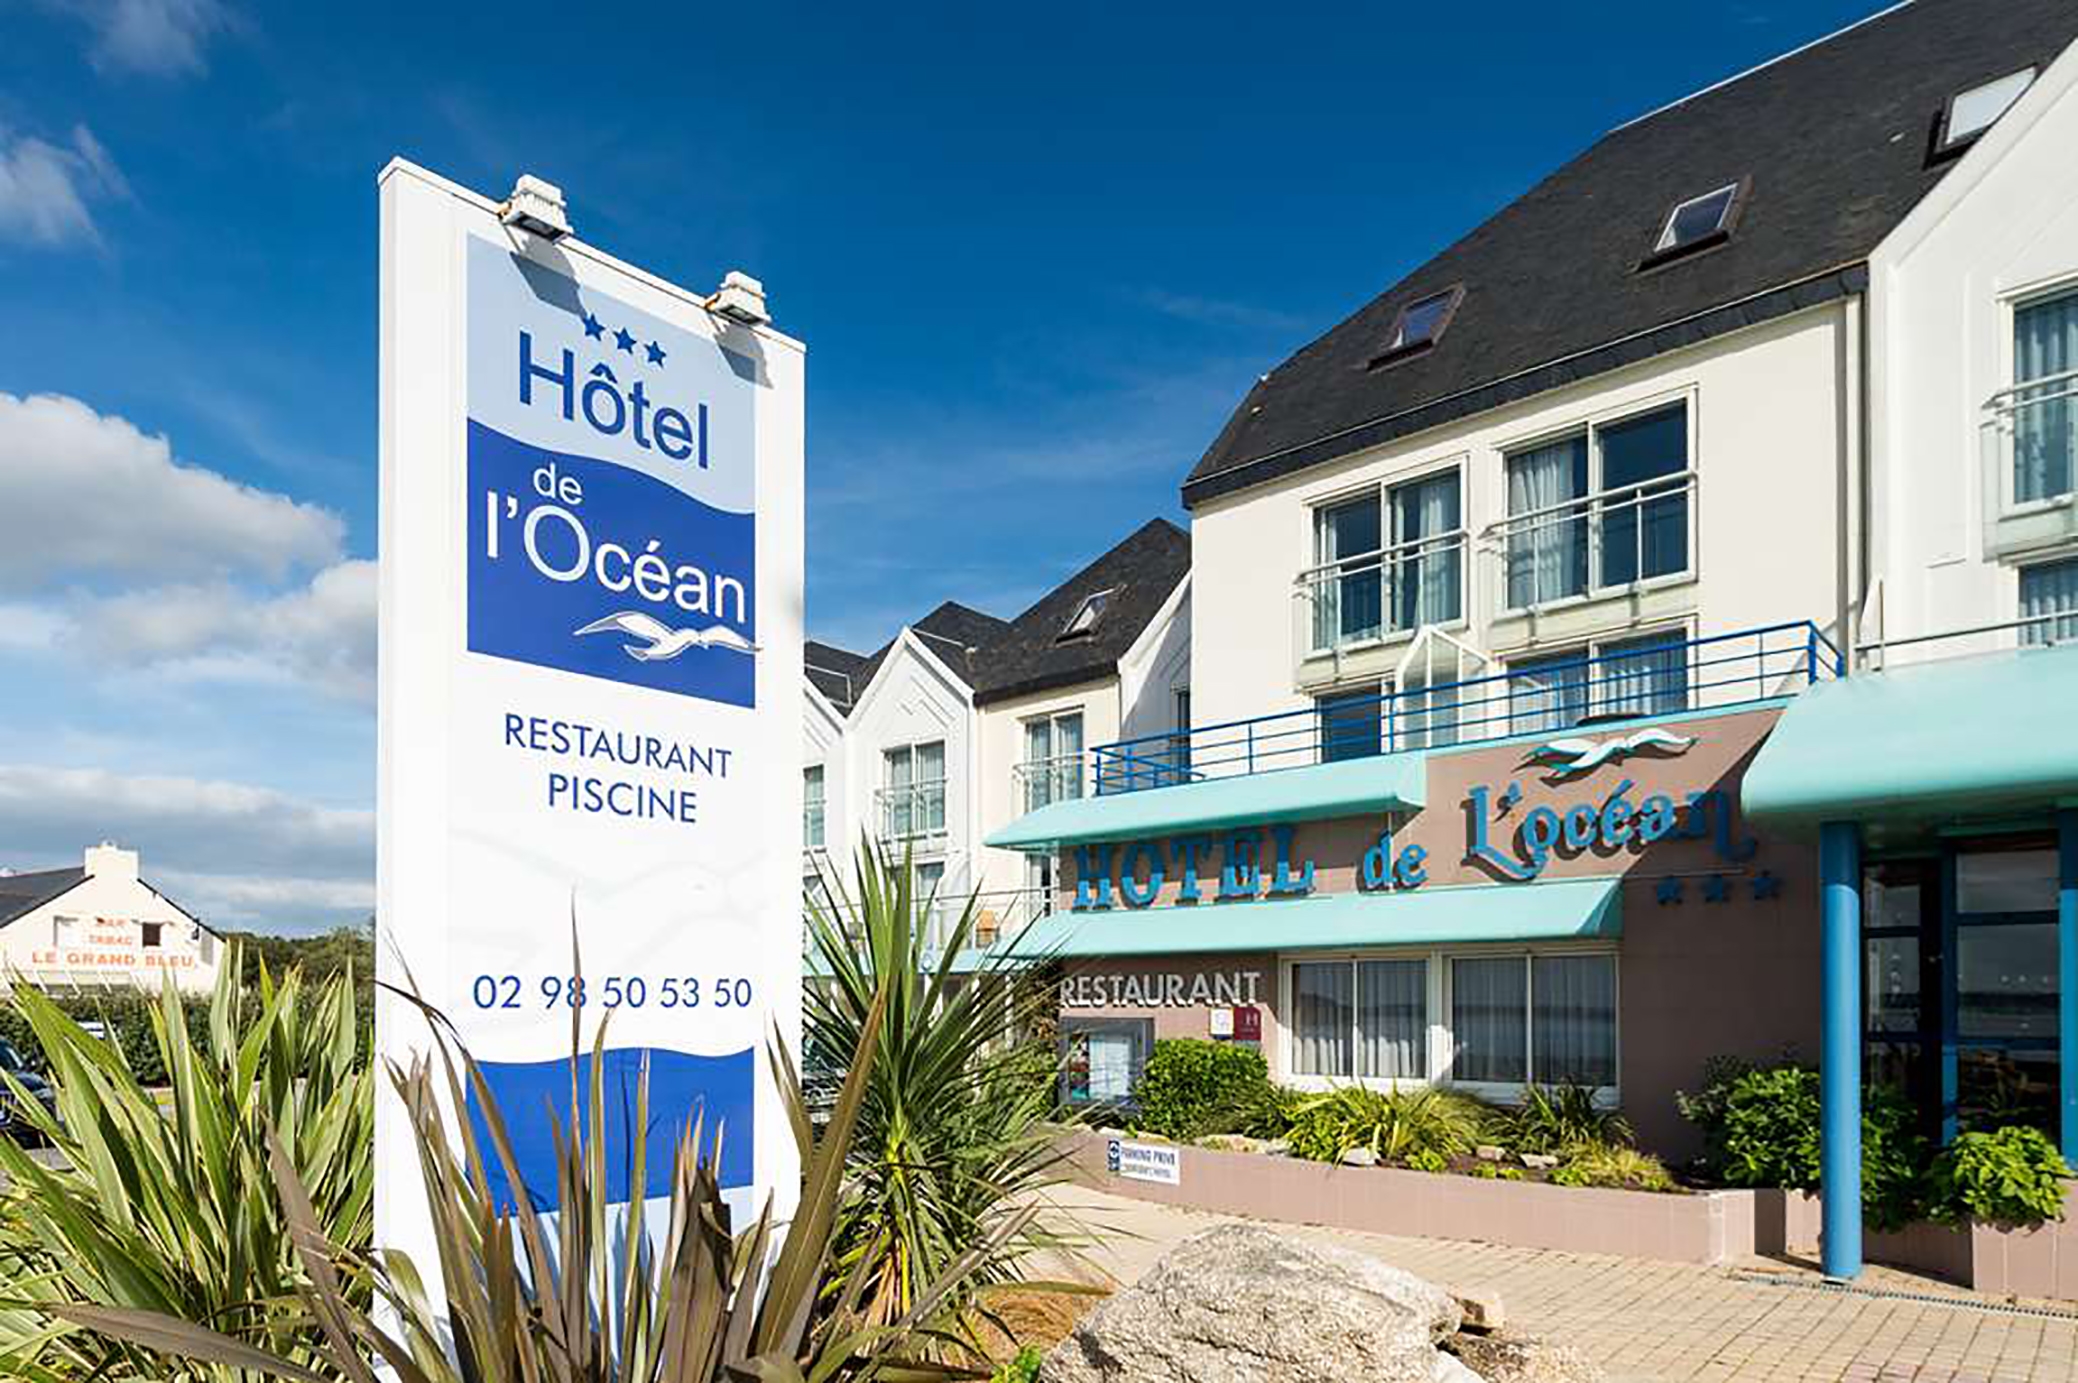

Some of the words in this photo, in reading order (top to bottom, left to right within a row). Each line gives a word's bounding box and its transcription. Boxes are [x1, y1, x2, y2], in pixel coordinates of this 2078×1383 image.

[519, 329, 708, 470] Hôtel
[533, 462, 584, 505] de
[505, 712, 733, 779] RESTAURANT
[549, 772, 698, 824] PISCINE
[1072, 824, 1316, 910] HOTEL
[1360, 829, 1429, 893] de
[32, 952, 57, 964] LE
[66, 952, 136, 966] GRAND
[145, 954, 194, 968] BLEU
[473, 974, 522, 1009] 02
[540, 975, 587, 1009] 98
[603, 976, 646, 1009] 50
[660, 977, 700, 1009] 53
[714, 977, 752, 1008] 50
[1059, 971, 1261, 1008] RESTAURANT
